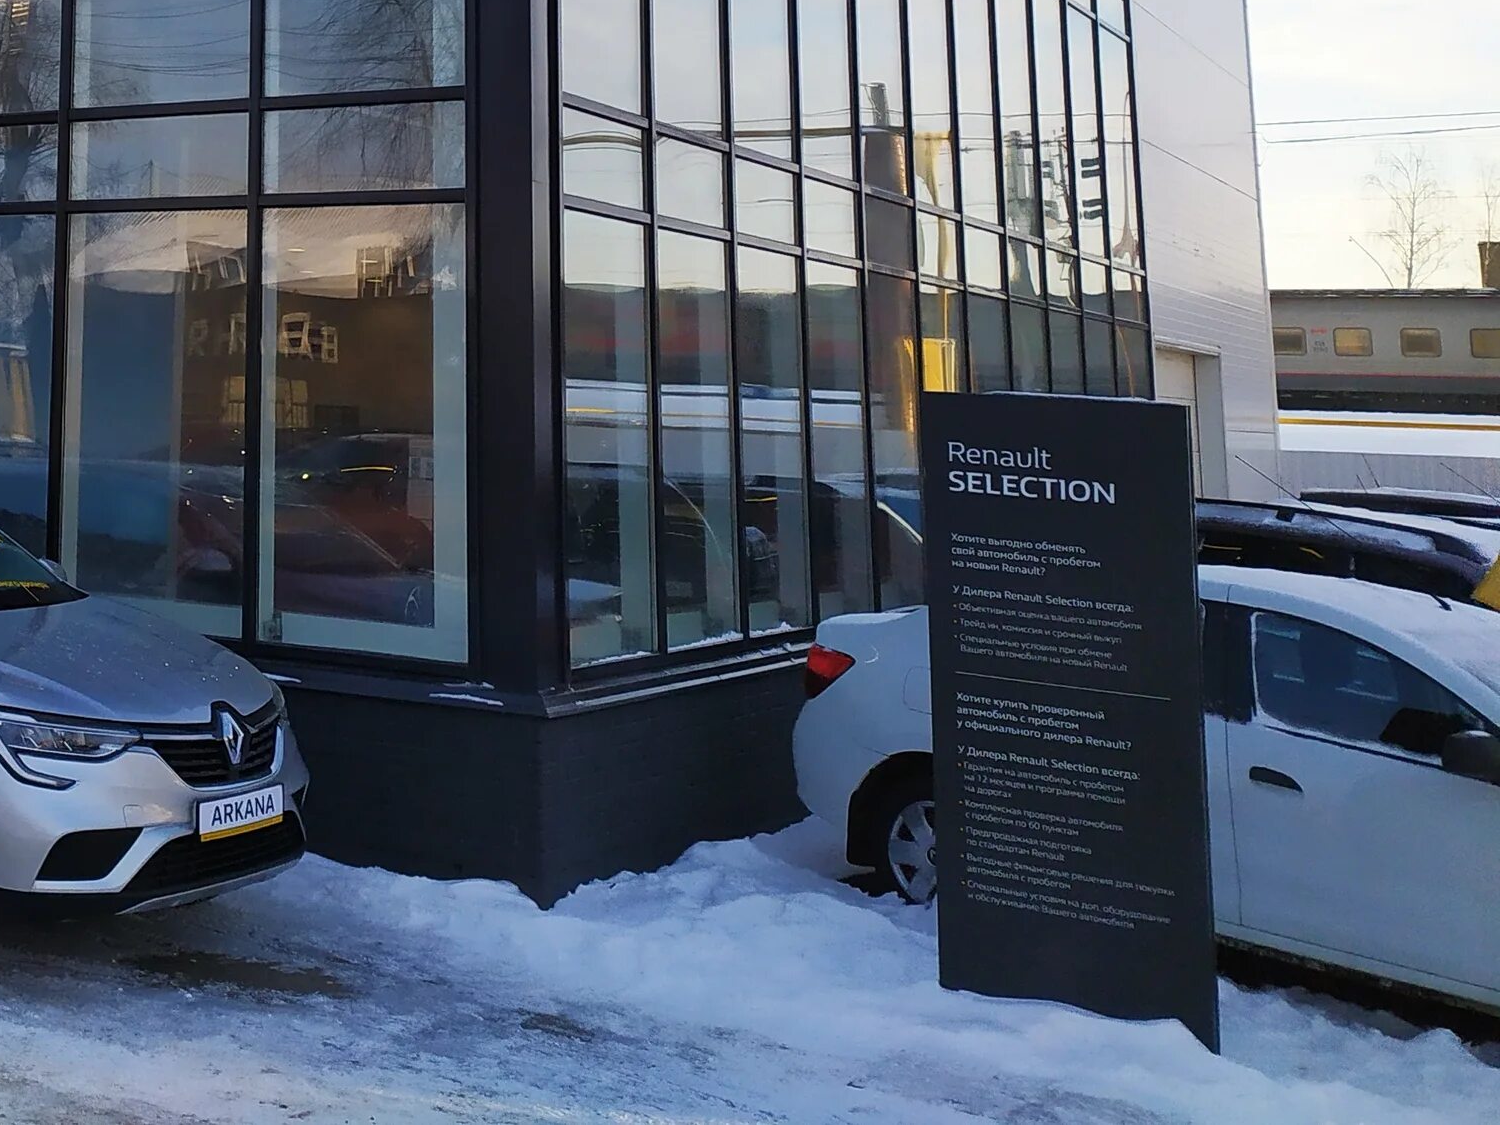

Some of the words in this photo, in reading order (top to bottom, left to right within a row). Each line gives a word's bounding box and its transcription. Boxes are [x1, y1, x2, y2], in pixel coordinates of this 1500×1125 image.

[947, 441, 1052, 470] Renault
[948, 470, 1117, 505] SELECTION
[951, 532, 987, 544] Хотите
[988, 538, 1033, 549] выгодно
[1035, 540, 1086, 554] обменять
[951, 546, 975, 556] свой
[977, 549, 1039, 563] автомобиль
[1049, 556, 1101, 568] пробегом
[951, 559, 964, 568] на
[1002, 563, 1046, 576] Renault?
[953, 584, 960, 594] У
[962, 586, 1002, 600] Дилера
[1004, 590, 1043, 604] Renault
[1045, 594, 1093, 609] Selection
[1095, 602, 1134, 613] всегда:
[956, 691, 992, 705] Хотите
[993, 698, 1029, 711] купить
[1031, 703, 1106, 721] проверенный
[956, 706, 1018, 722] автомобиль
[1020, 715, 1026, 723] с
[1028, 715, 1079, 731] пробегом
[956, 719, 963, 729] у
[965, 719, 1041, 738] официального
[1043, 731, 1084, 745] дилера
[1085, 735, 1132, 751] Renault?
[957, 744, 965, 754] У
[967, 746, 1008, 762] Дилера
[1009, 751, 1049, 767] Renault
[1051, 758, 1099, 774] Selection
[1101, 767, 1141, 782] всегда:
[211, 793, 275, 826] ARKANA
